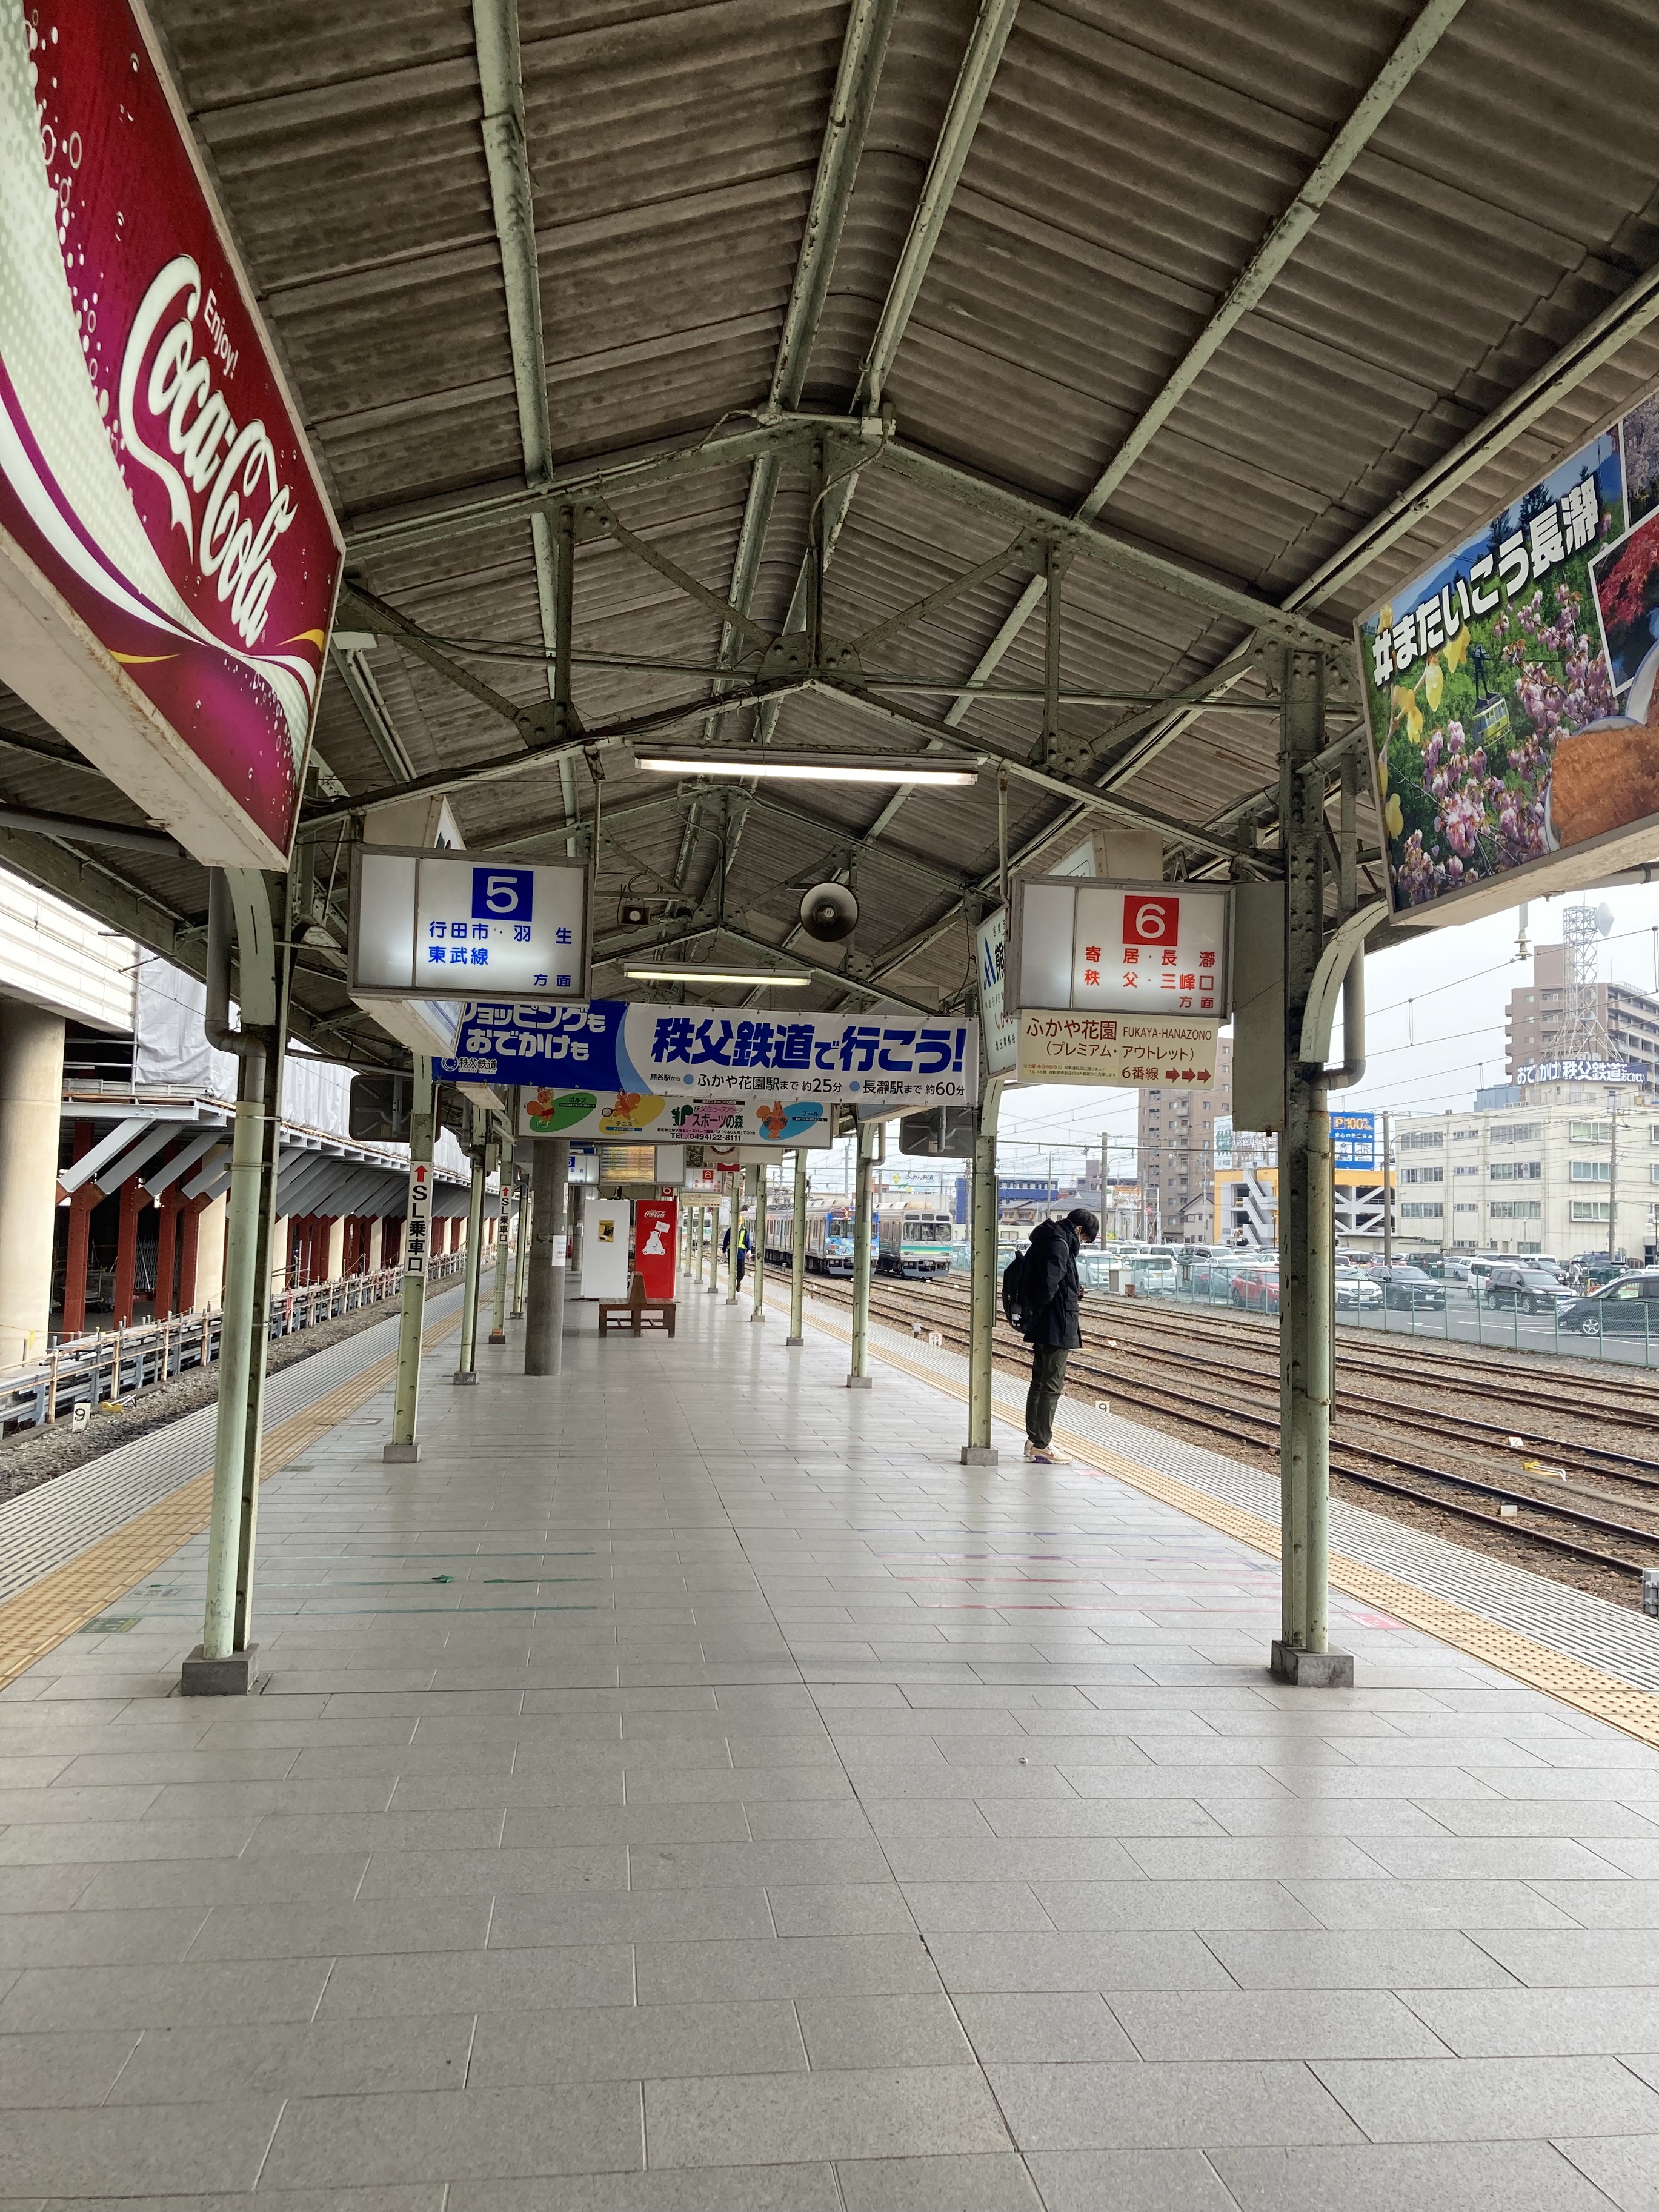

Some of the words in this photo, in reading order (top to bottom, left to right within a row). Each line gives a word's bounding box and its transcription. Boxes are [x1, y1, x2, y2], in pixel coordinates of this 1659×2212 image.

[203, 288, 239, 379] Enjoy!
[119, 253, 298, 647] Coca-Cola
[1372, 474, 1598, 686] #またいこう長瀞
[486, 875, 519, 914] 5
[1135, 903, 1166, 938] 6
[428, 945, 488, 965] 東武線
[533, 974, 571, 988] 方面
[1179, 996, 1214, 1009] 方面
[1026, 1018, 1117, 1041] ふかや花園
[1123, 1026, 1212, 1041] FUKAYA-HANAZONO
[466, 1028, 590, 1061] おでかけも
[651, 1017, 967, 1074] 秩父鉄道で行こう!
[459, 1057, 497, 1070] 秩父鉄道
[650, 1073, 681, 1083] 熊谷駅から
[1122, 1066, 1159, 1081] 6番線
[802, 1078, 843, 1094] 約25分
[925, 1081, 965, 1097] 約60分
[694, 1105, 743, 1114] 秩父ミューズパーク
[692, 1113, 743, 1129] スポーツの森
[75, 1408, 85, 1421] 9
